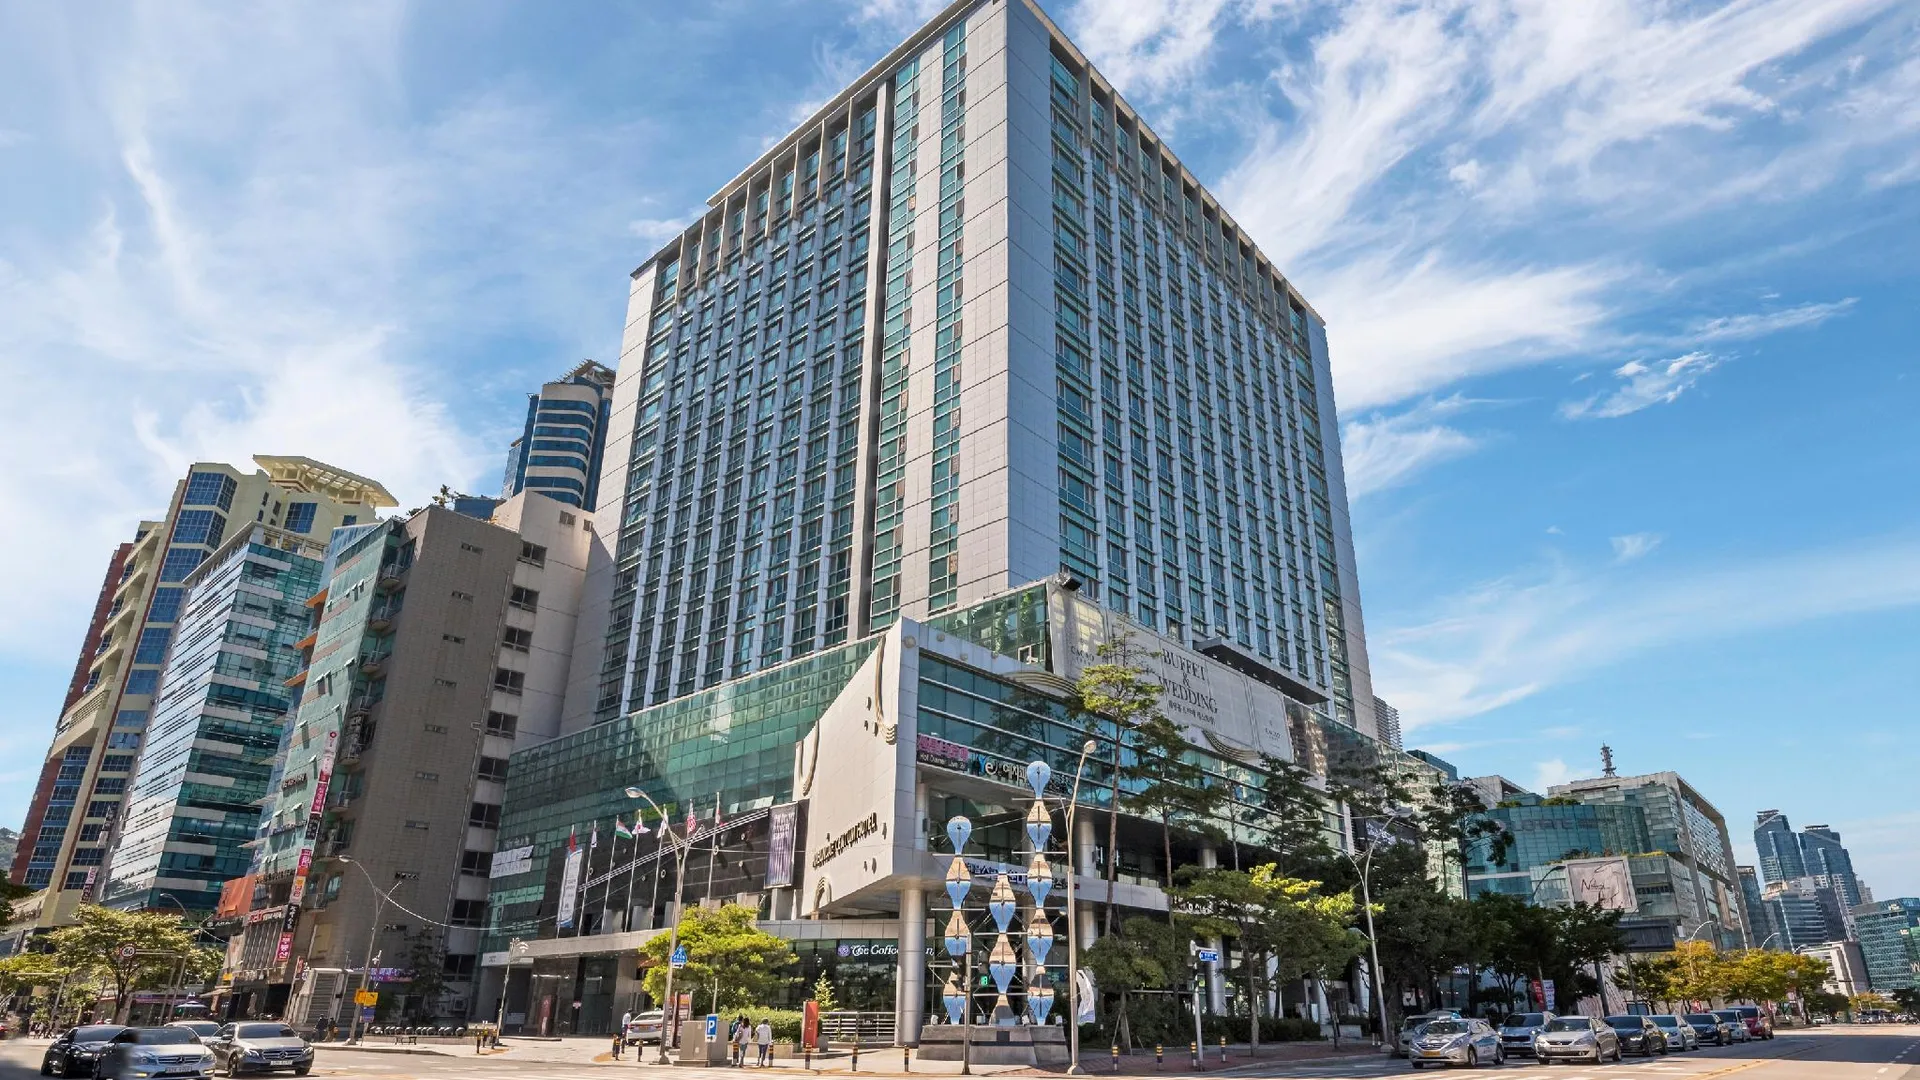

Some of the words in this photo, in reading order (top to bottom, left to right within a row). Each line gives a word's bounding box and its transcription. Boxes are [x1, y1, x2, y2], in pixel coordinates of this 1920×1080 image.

[1162, 648, 1206, 681] BUFFET
[1183, 672, 1191, 688] &
[1159, 676, 1218, 714] WEDDING
[870, 944, 900, 956] Coffe
[708, 1020, 715, 1034] P
